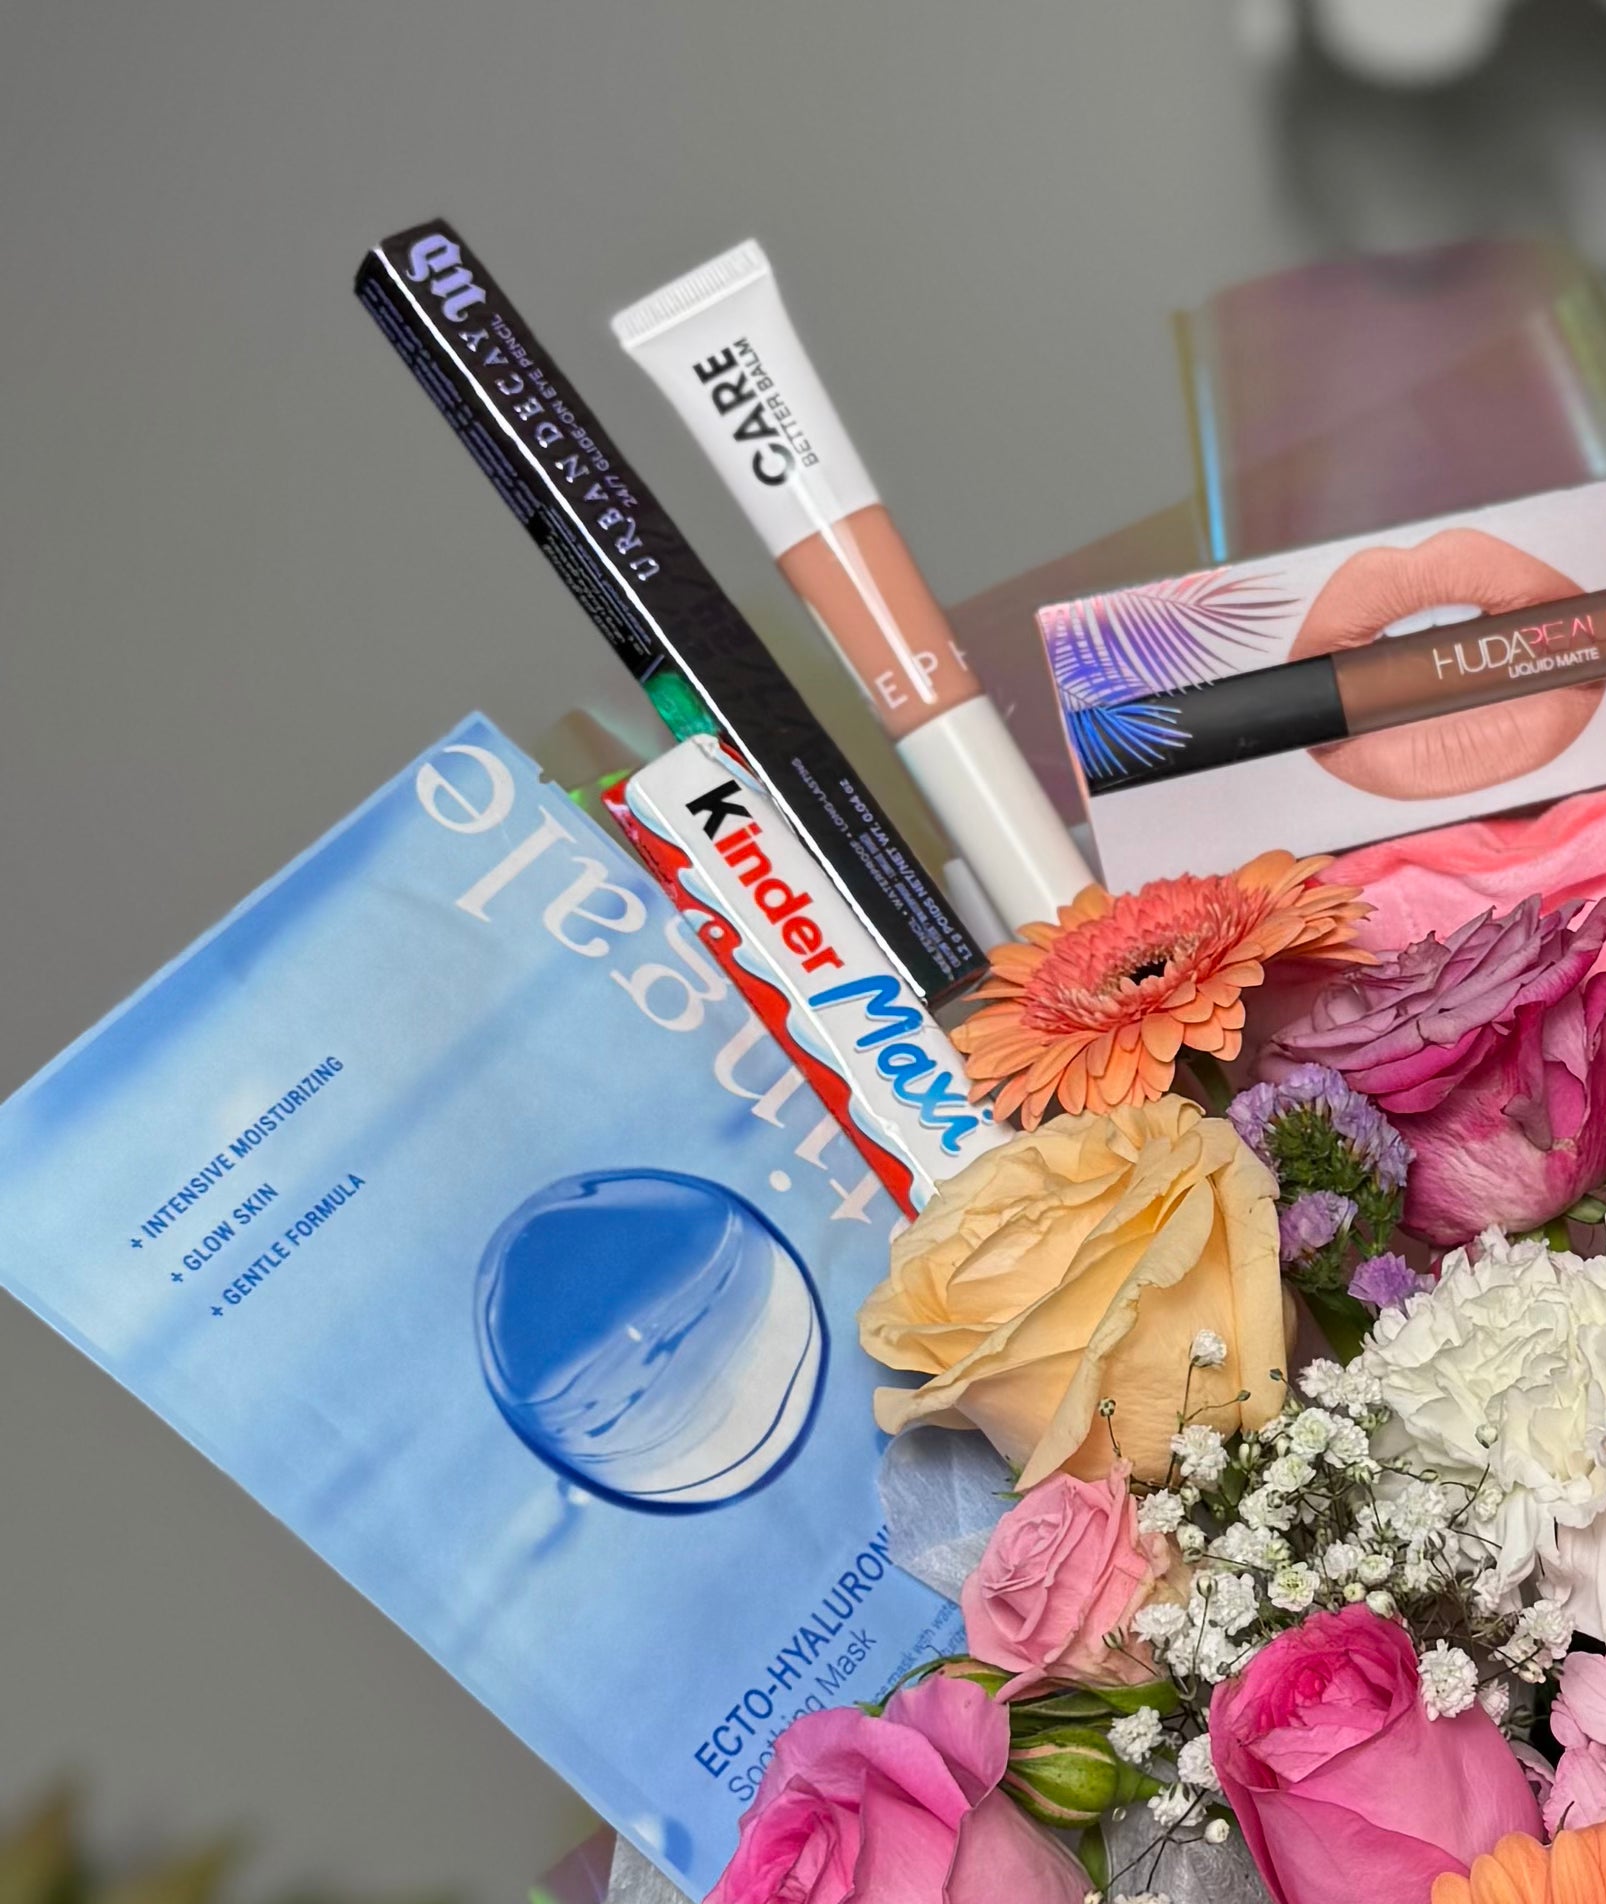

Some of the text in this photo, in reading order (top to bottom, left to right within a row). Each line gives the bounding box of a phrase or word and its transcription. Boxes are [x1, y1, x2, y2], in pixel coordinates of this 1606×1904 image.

[457, 320, 564, 451] DECAY
[488, 313, 638, 508] 24/7 GLIDE-ON EYE PENCIL
[693, 347, 794, 488] CARE
[733, 336, 819, 469] BETTER BALM
[554, 451, 659, 582] URBAN
[1508, 646, 1599, 678] LIQUID MATTE
[685, 780, 844, 975] Kinder
[922, 895, 954, 934] POIDS
[416, 743, 912, 1238] tingale
[808, 973, 993, 1155] Maxi
[140, 1151, 235, 1239] INTENSIVE
[229, 1053, 344, 1158] MOISTURIZING
[181, 1220, 236, 1273] GLOW
[231, 1181, 279, 1227] SKIN
[221, 1241, 290, 1307] GENTLE
[284, 1170, 366, 1247] FORMULA
[813, 1625, 877, 1696] Mask
